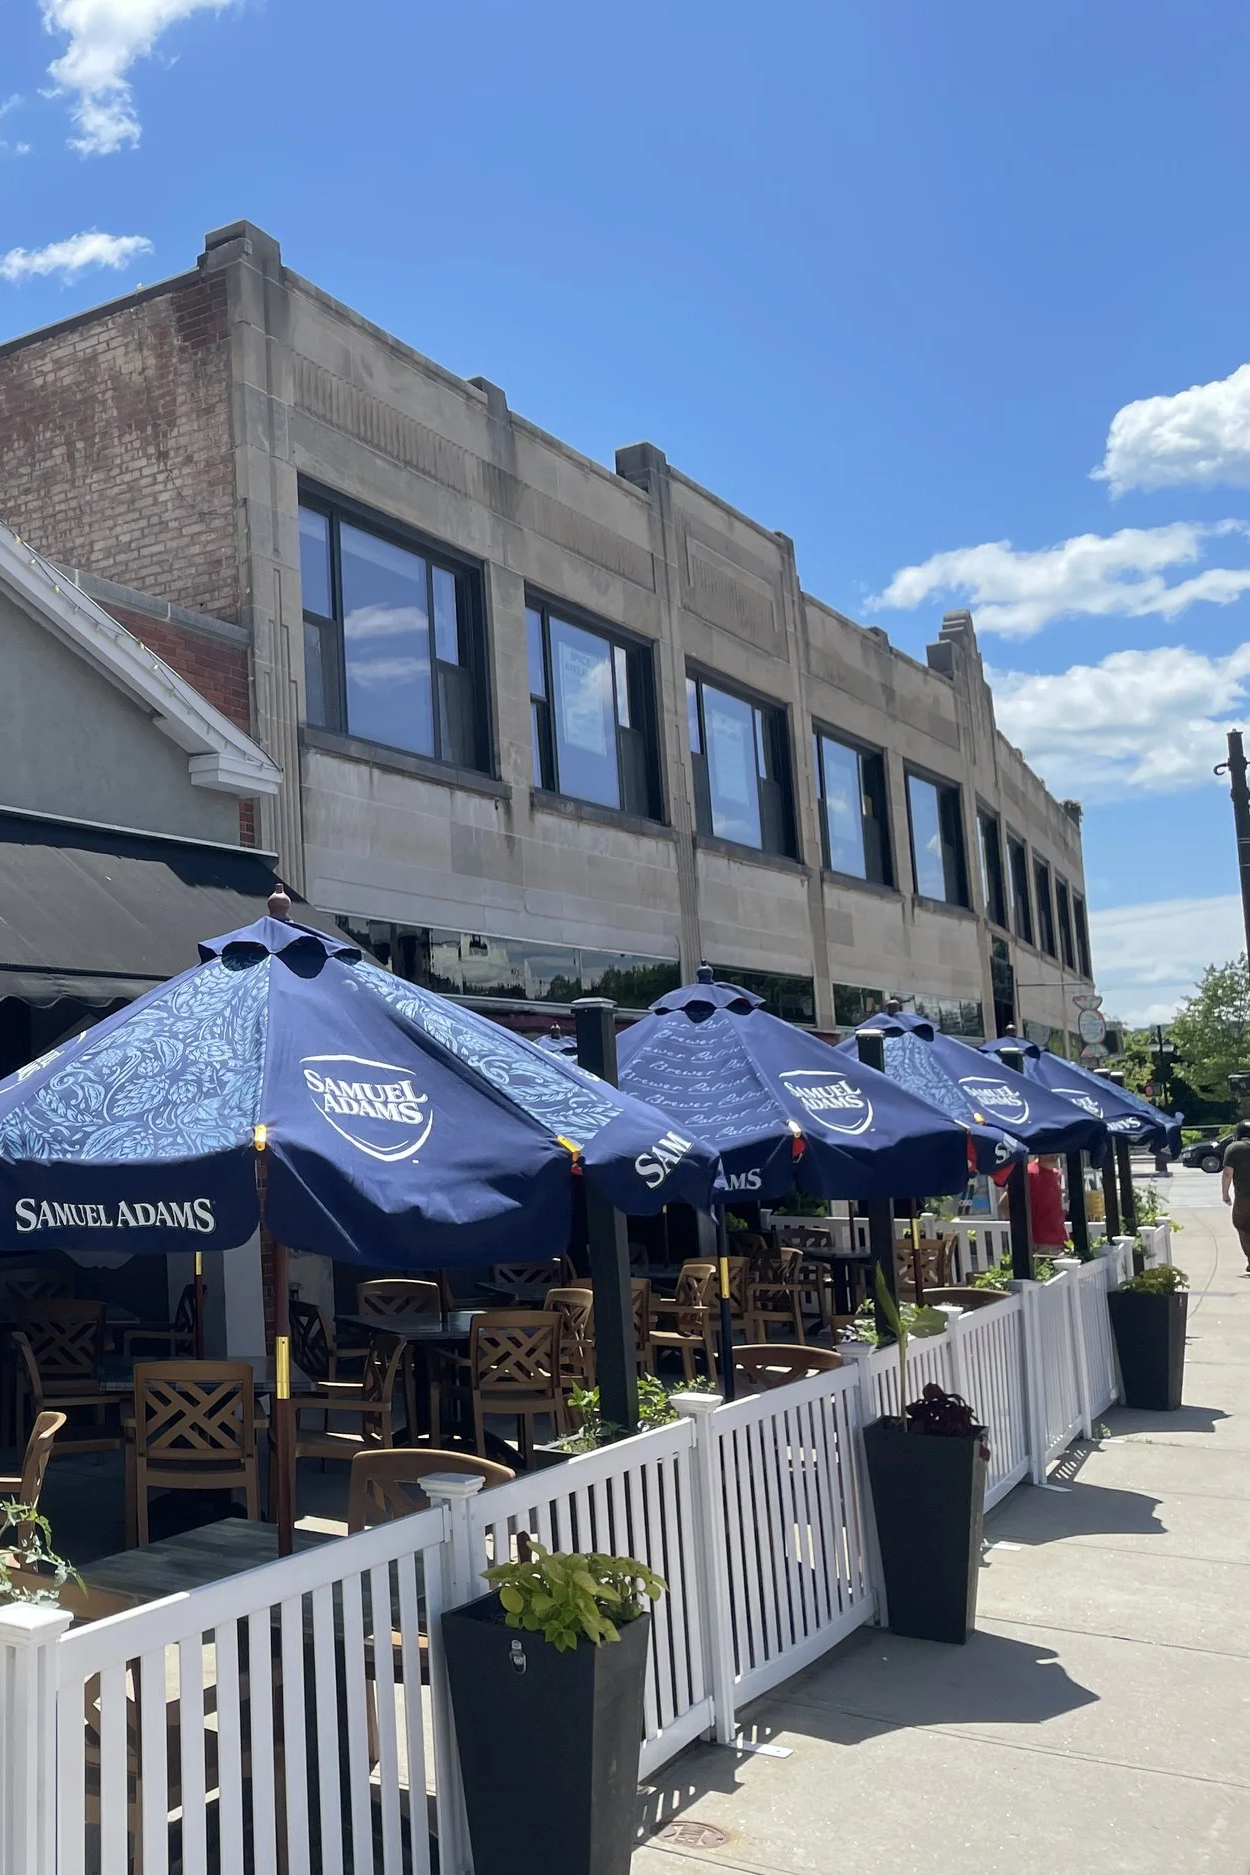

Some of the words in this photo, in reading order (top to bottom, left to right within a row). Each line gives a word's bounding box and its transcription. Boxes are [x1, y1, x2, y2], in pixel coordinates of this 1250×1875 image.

[649, 1061, 716, 1076] Brewer
[303, 1069, 428, 1103] SAMUEL
[688, 1075, 751, 1091] Patriot
[784, 1080, 861, 1098] SAMUEL
[962, 1086, 1020, 1098] SAMUEL
[323, 1094, 423, 1124] ADAMS
[645, 1094, 713, 1108] Brewer
[801, 1095, 864, 1110] ADAMS
[15, 1198, 112, 1232] SAMUEL
[117, 1198, 215, 1233] ADAMS
